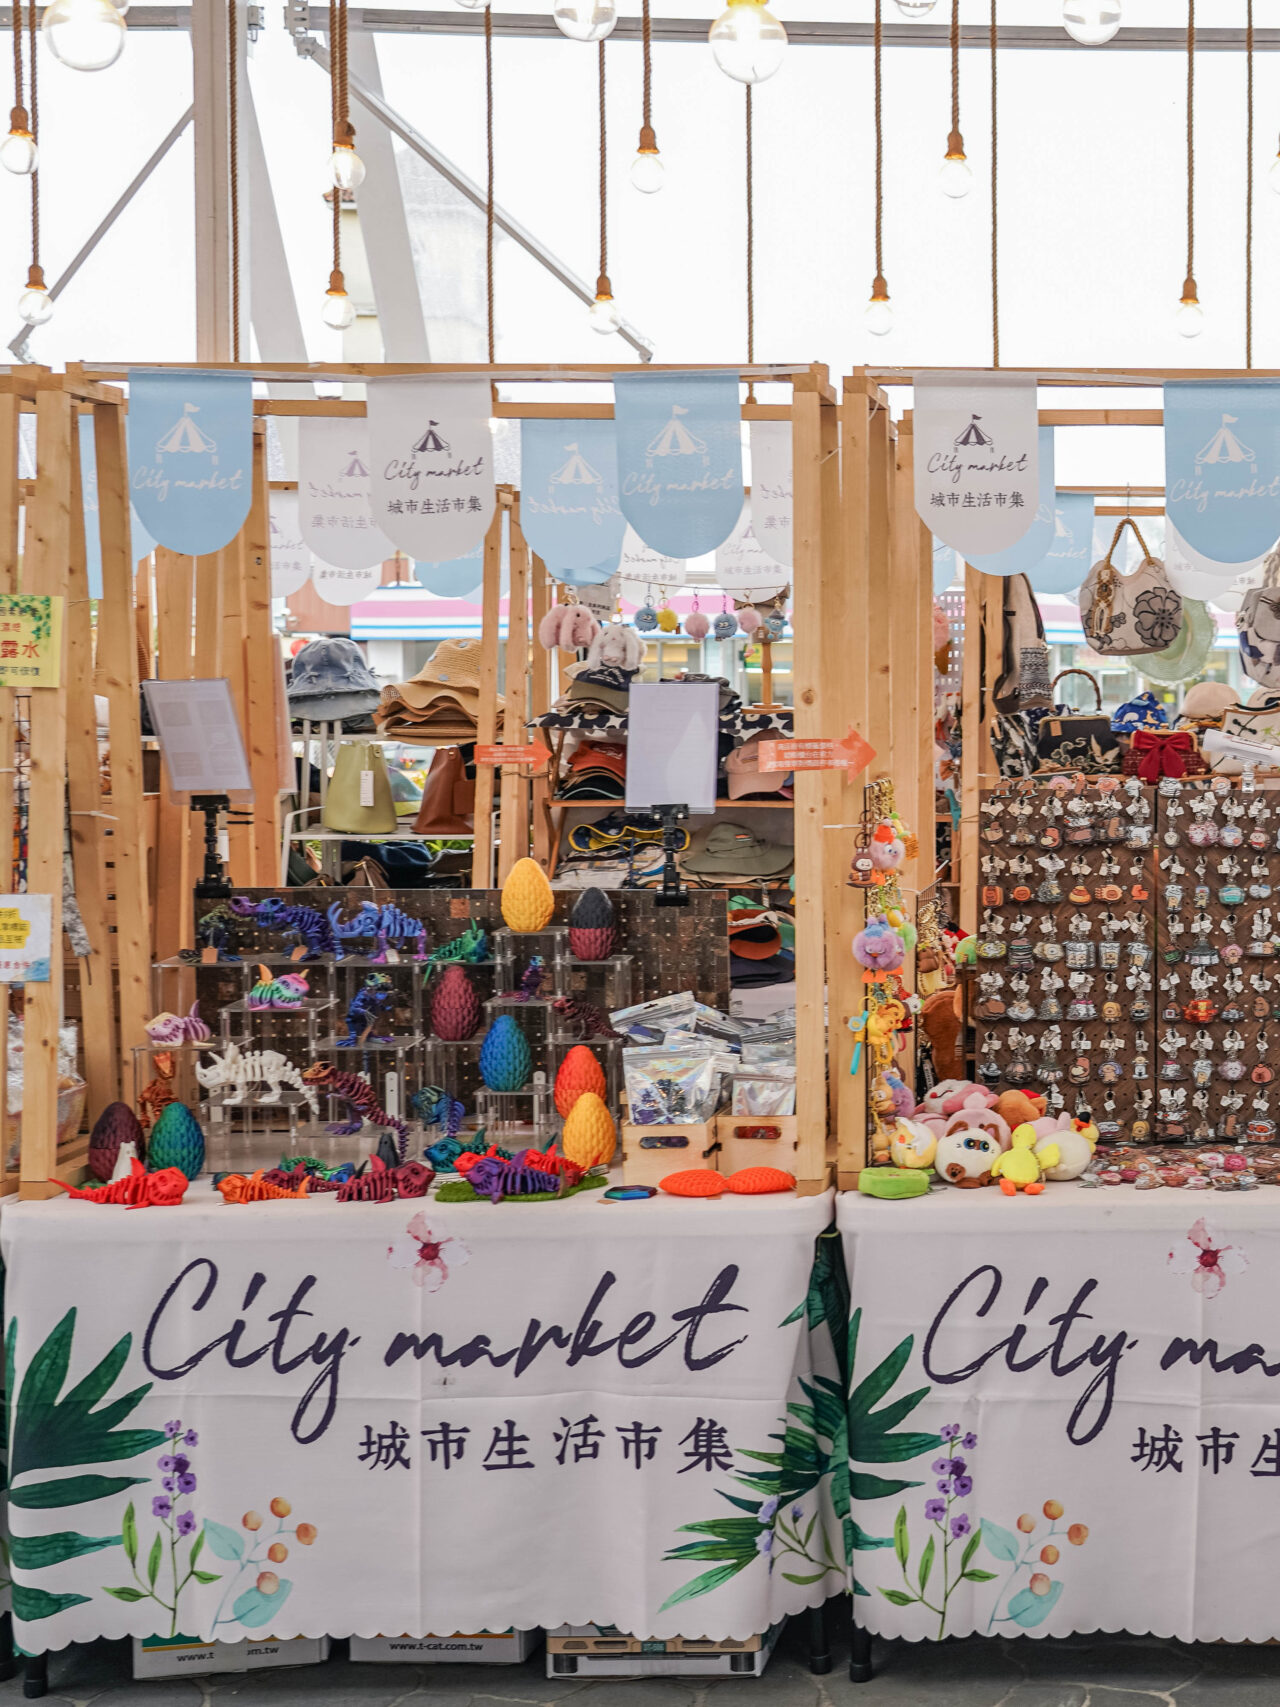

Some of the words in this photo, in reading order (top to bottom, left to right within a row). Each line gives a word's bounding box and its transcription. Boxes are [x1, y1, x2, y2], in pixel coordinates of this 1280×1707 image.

[132, 465, 170, 502] City
[174, 468, 244, 490] market
[383, 459, 421, 491] City
[425, 456, 485, 478] market
[926, 452, 963, 484] City
[967, 453, 1028, 472] market
[386, 495, 483, 515] 城市生活市集
[621, 471, 661, 506] City
[666, 468, 735, 492] market
[929, 491, 1025, 509] 城市生活市集
[1170, 478, 1210, 513] City
[1214, 476, 1280, 498] market
[142, 1257, 361, 1445] City
[384, 1263, 749, 1379] market
[922, 1265, 1138, 1445] City
[357, 1413, 736, 1474] 城市生活市集
[389, 1642, 484, 1651] www.t-cat.com.tw
